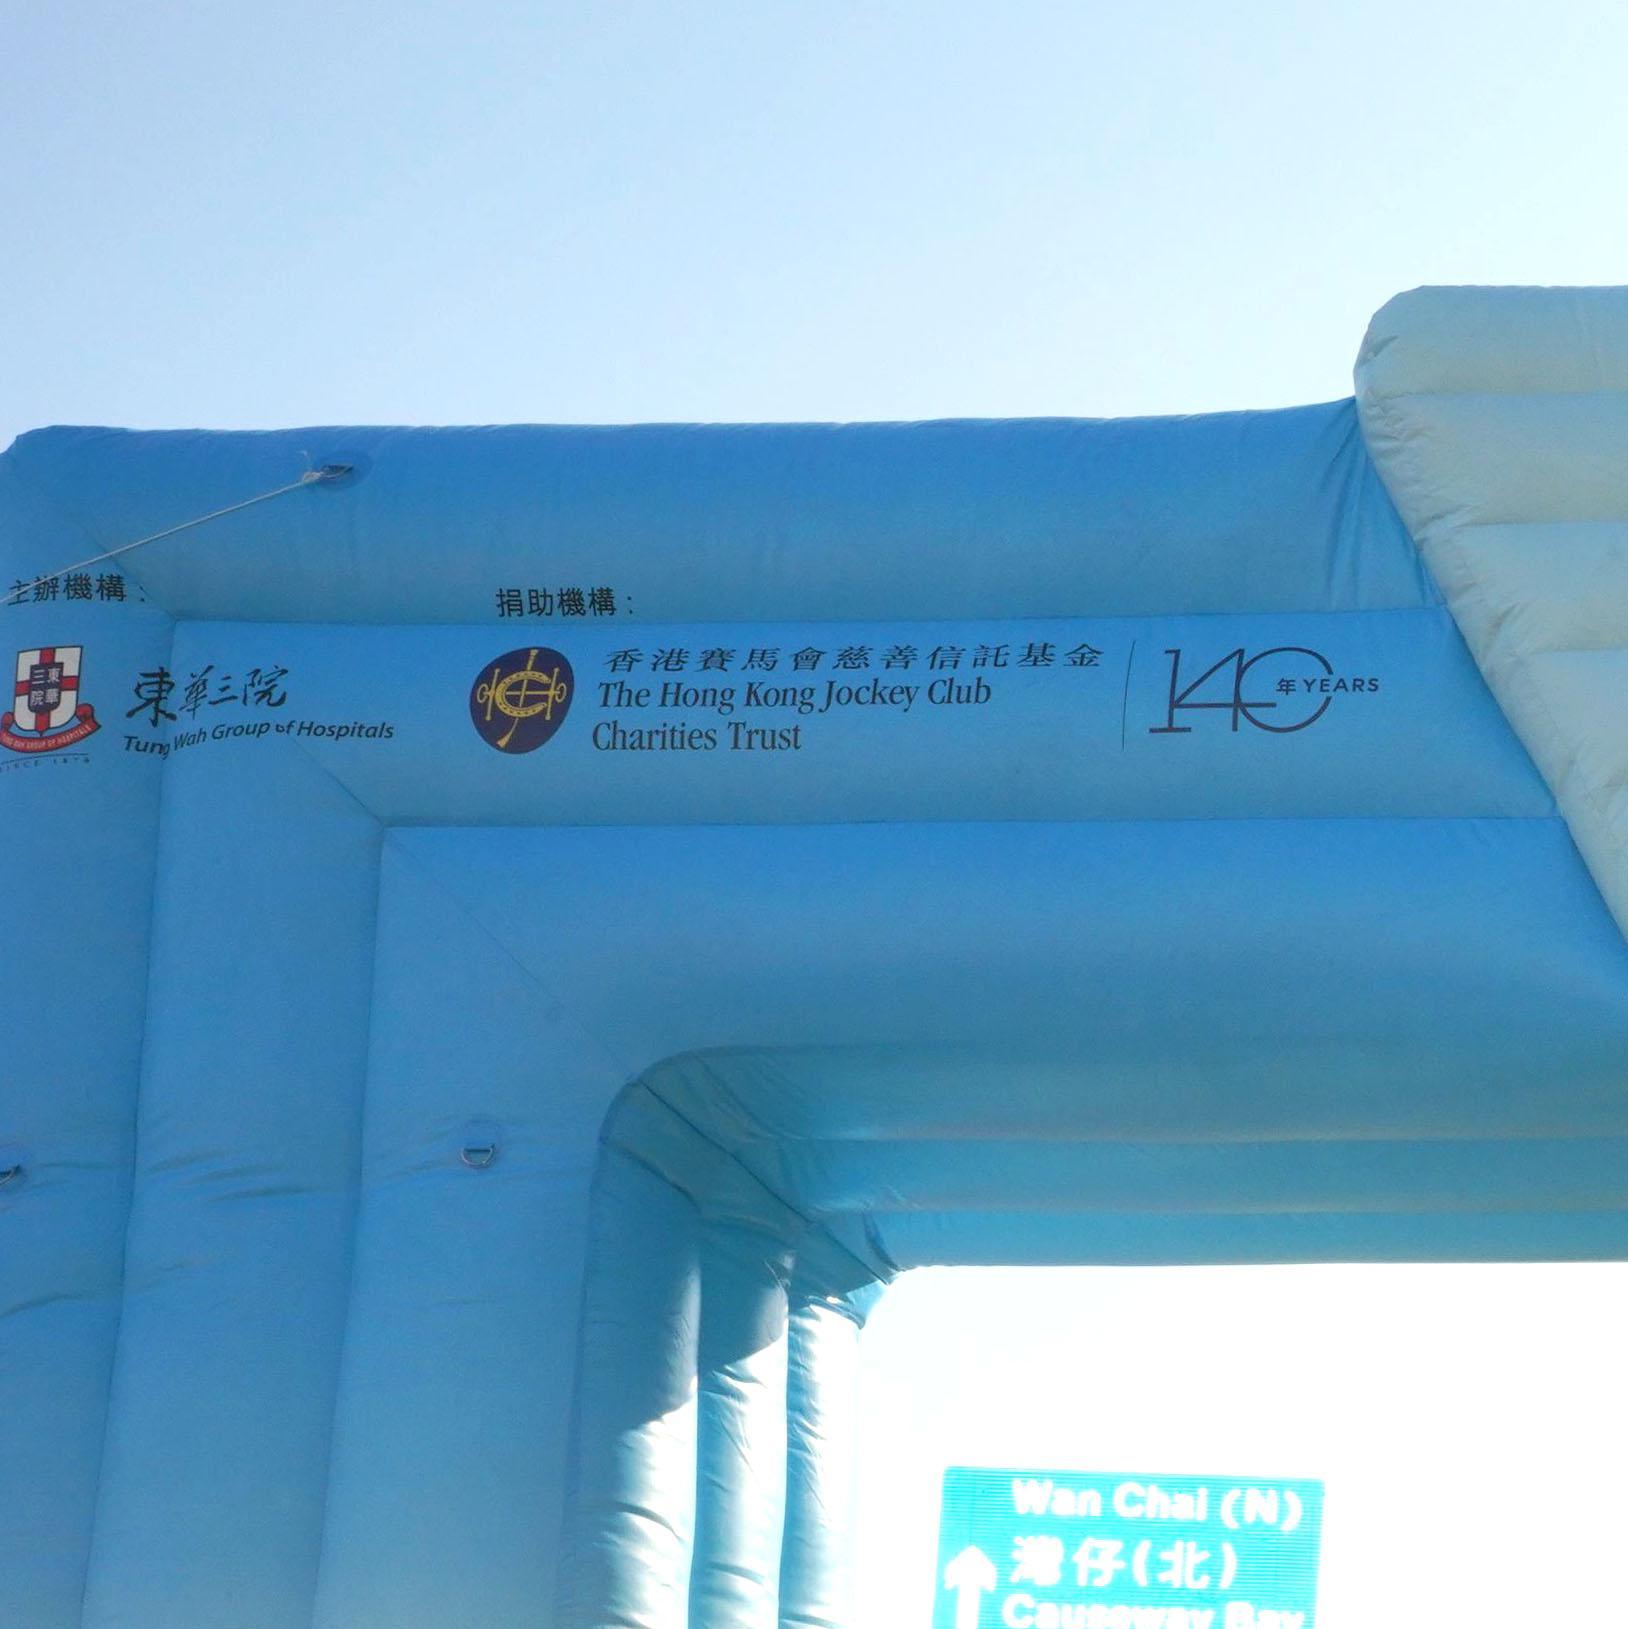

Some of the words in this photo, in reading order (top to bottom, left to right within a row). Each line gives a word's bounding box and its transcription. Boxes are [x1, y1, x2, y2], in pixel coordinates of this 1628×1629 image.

[602, 642, 1105, 676] 香港賽馬會慈善信託基金
[597, 680, 656, 709] The
[657, 680, 736, 716] Hong
[744, 679, 816, 715] Kong
[817, 678, 921, 715] Jockey
[926, 677, 992, 706] Club
[1304, 676, 1380, 692] YEARS
[122, 734, 170, 760] Tung
[172, 725, 208, 752] Wah
[210, 720, 271, 744] Group
[274, 718, 297, 736] of
[297, 720, 395, 746] Hospitals
[591, 721, 718, 753] Charities
[727, 721, 803, 753] Trust
[1011, 1479, 1102, 1517] Wan
[1113, 1483, 1208, 1521] Chai
[1220, 1489, 1302, 1533] (N)
